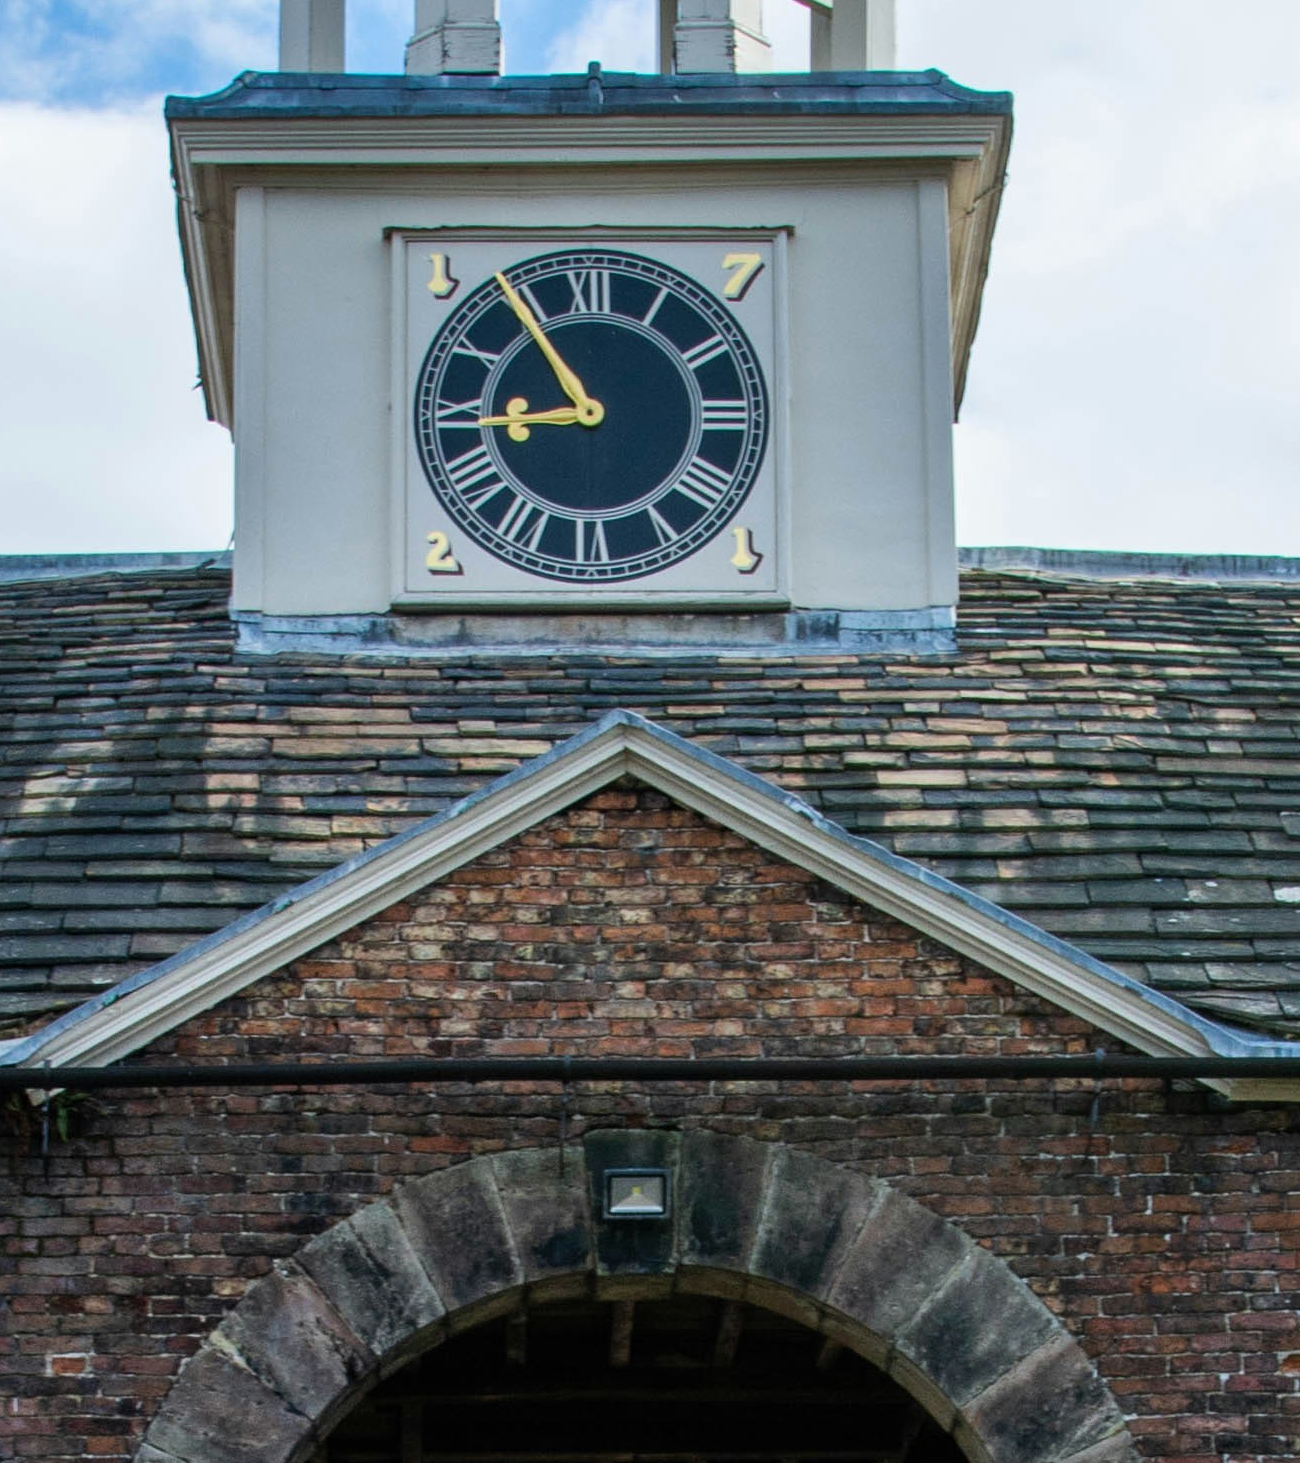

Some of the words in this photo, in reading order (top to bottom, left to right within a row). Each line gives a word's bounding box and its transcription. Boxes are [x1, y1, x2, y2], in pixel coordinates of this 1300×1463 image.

[427, 252, 455, 297] 1
[567, 270, 610, 313] XII
[721, 252, 763, 299] 7
[642, 287, 669, 326] I
[451, 336, 501, 370] X
[681, 334, 729, 371] II
[436, 398, 483, 429] IX
[701, 399, 748, 430] III
[445, 444, 509, 511] VIII
[672, 455, 733, 511] IIII
[496, 494, 551, 553] VII
[576, 519, 610, 563] VI
[647, 504, 680, 546] V
[426, 530, 460, 573] 2
[730, 525, 758, 572] 1
